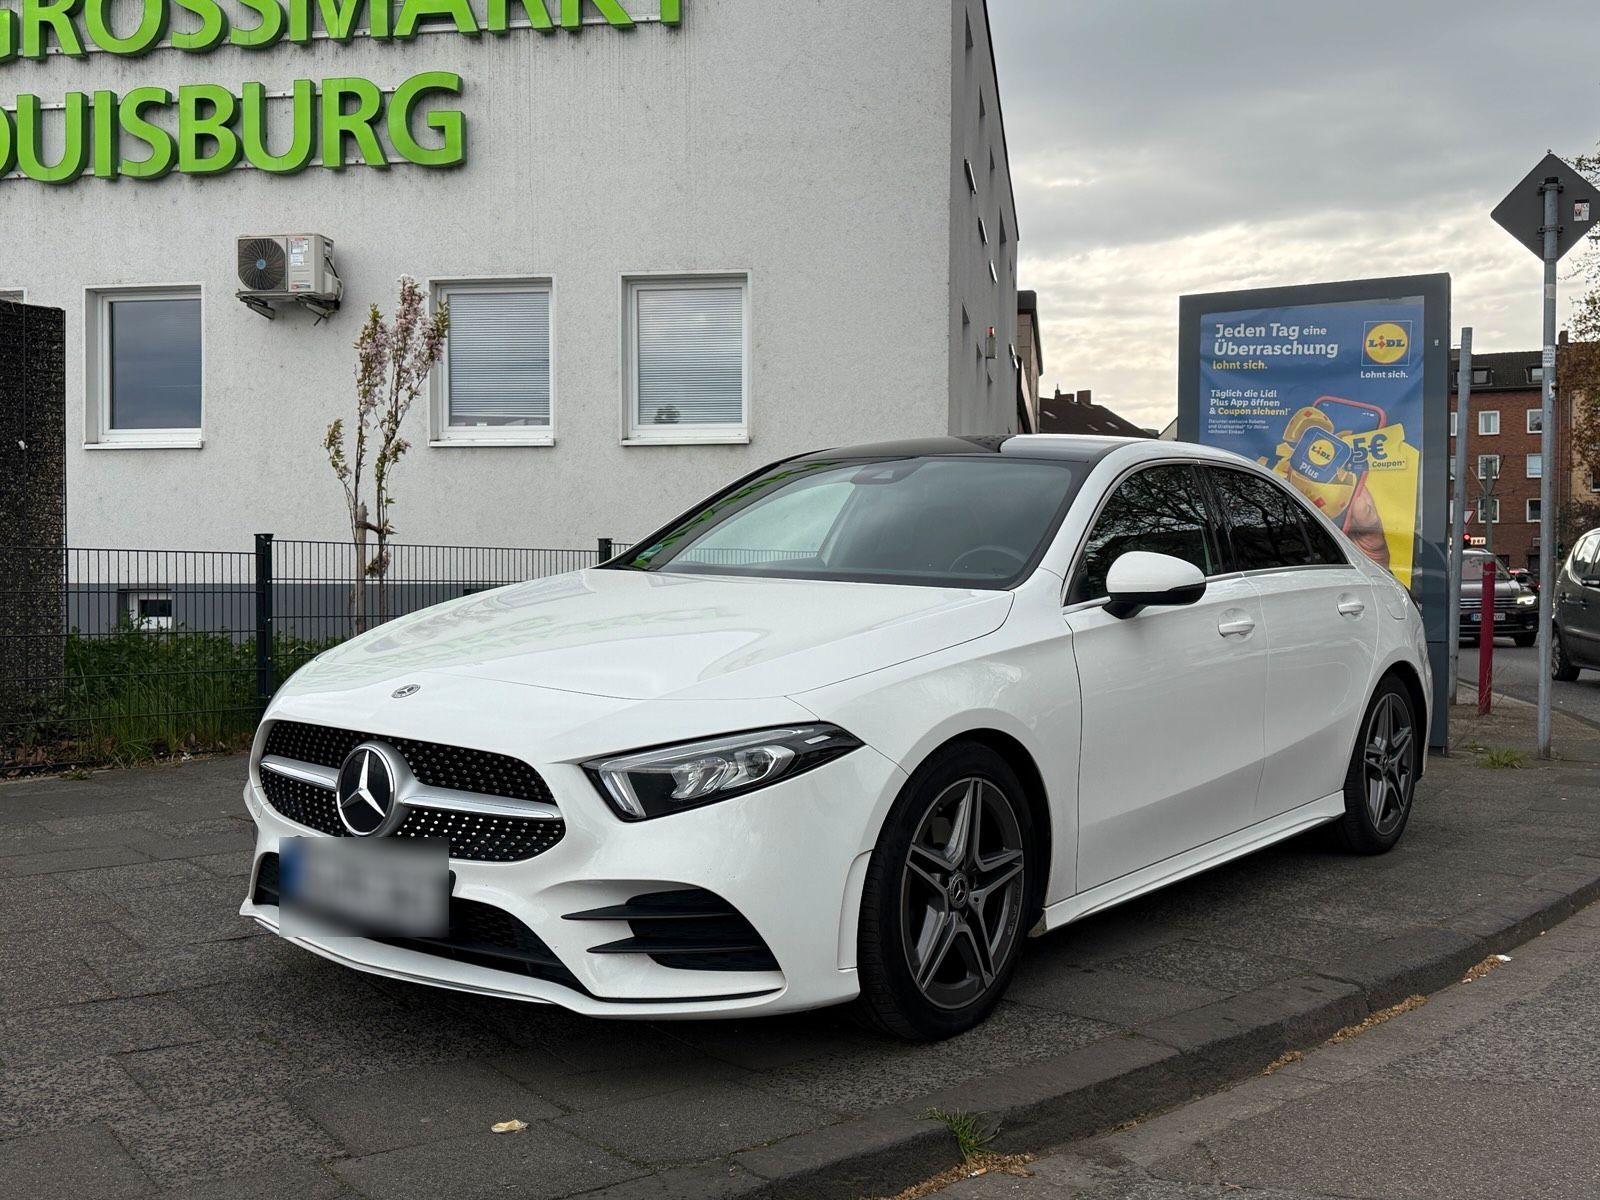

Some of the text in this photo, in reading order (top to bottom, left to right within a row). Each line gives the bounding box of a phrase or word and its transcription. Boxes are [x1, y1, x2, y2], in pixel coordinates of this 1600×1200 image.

[1215, 322, 1328, 340] Jeden Tag eine
[1213, 338, 1339, 358] Überraschung
[1212, 360, 1268, 369] lohnt sich.
[1360, 370, 1409, 378] Lohnt sich.
[1210, 389, 1277, 399] Täglich die Lidl
[1210, 398, 1280, 407] Plus App öffnen
[1208, 407, 1216, 415] &
[1217, 407, 1251, 416] Coupon
[1299, 461, 1319, 479] Plus
